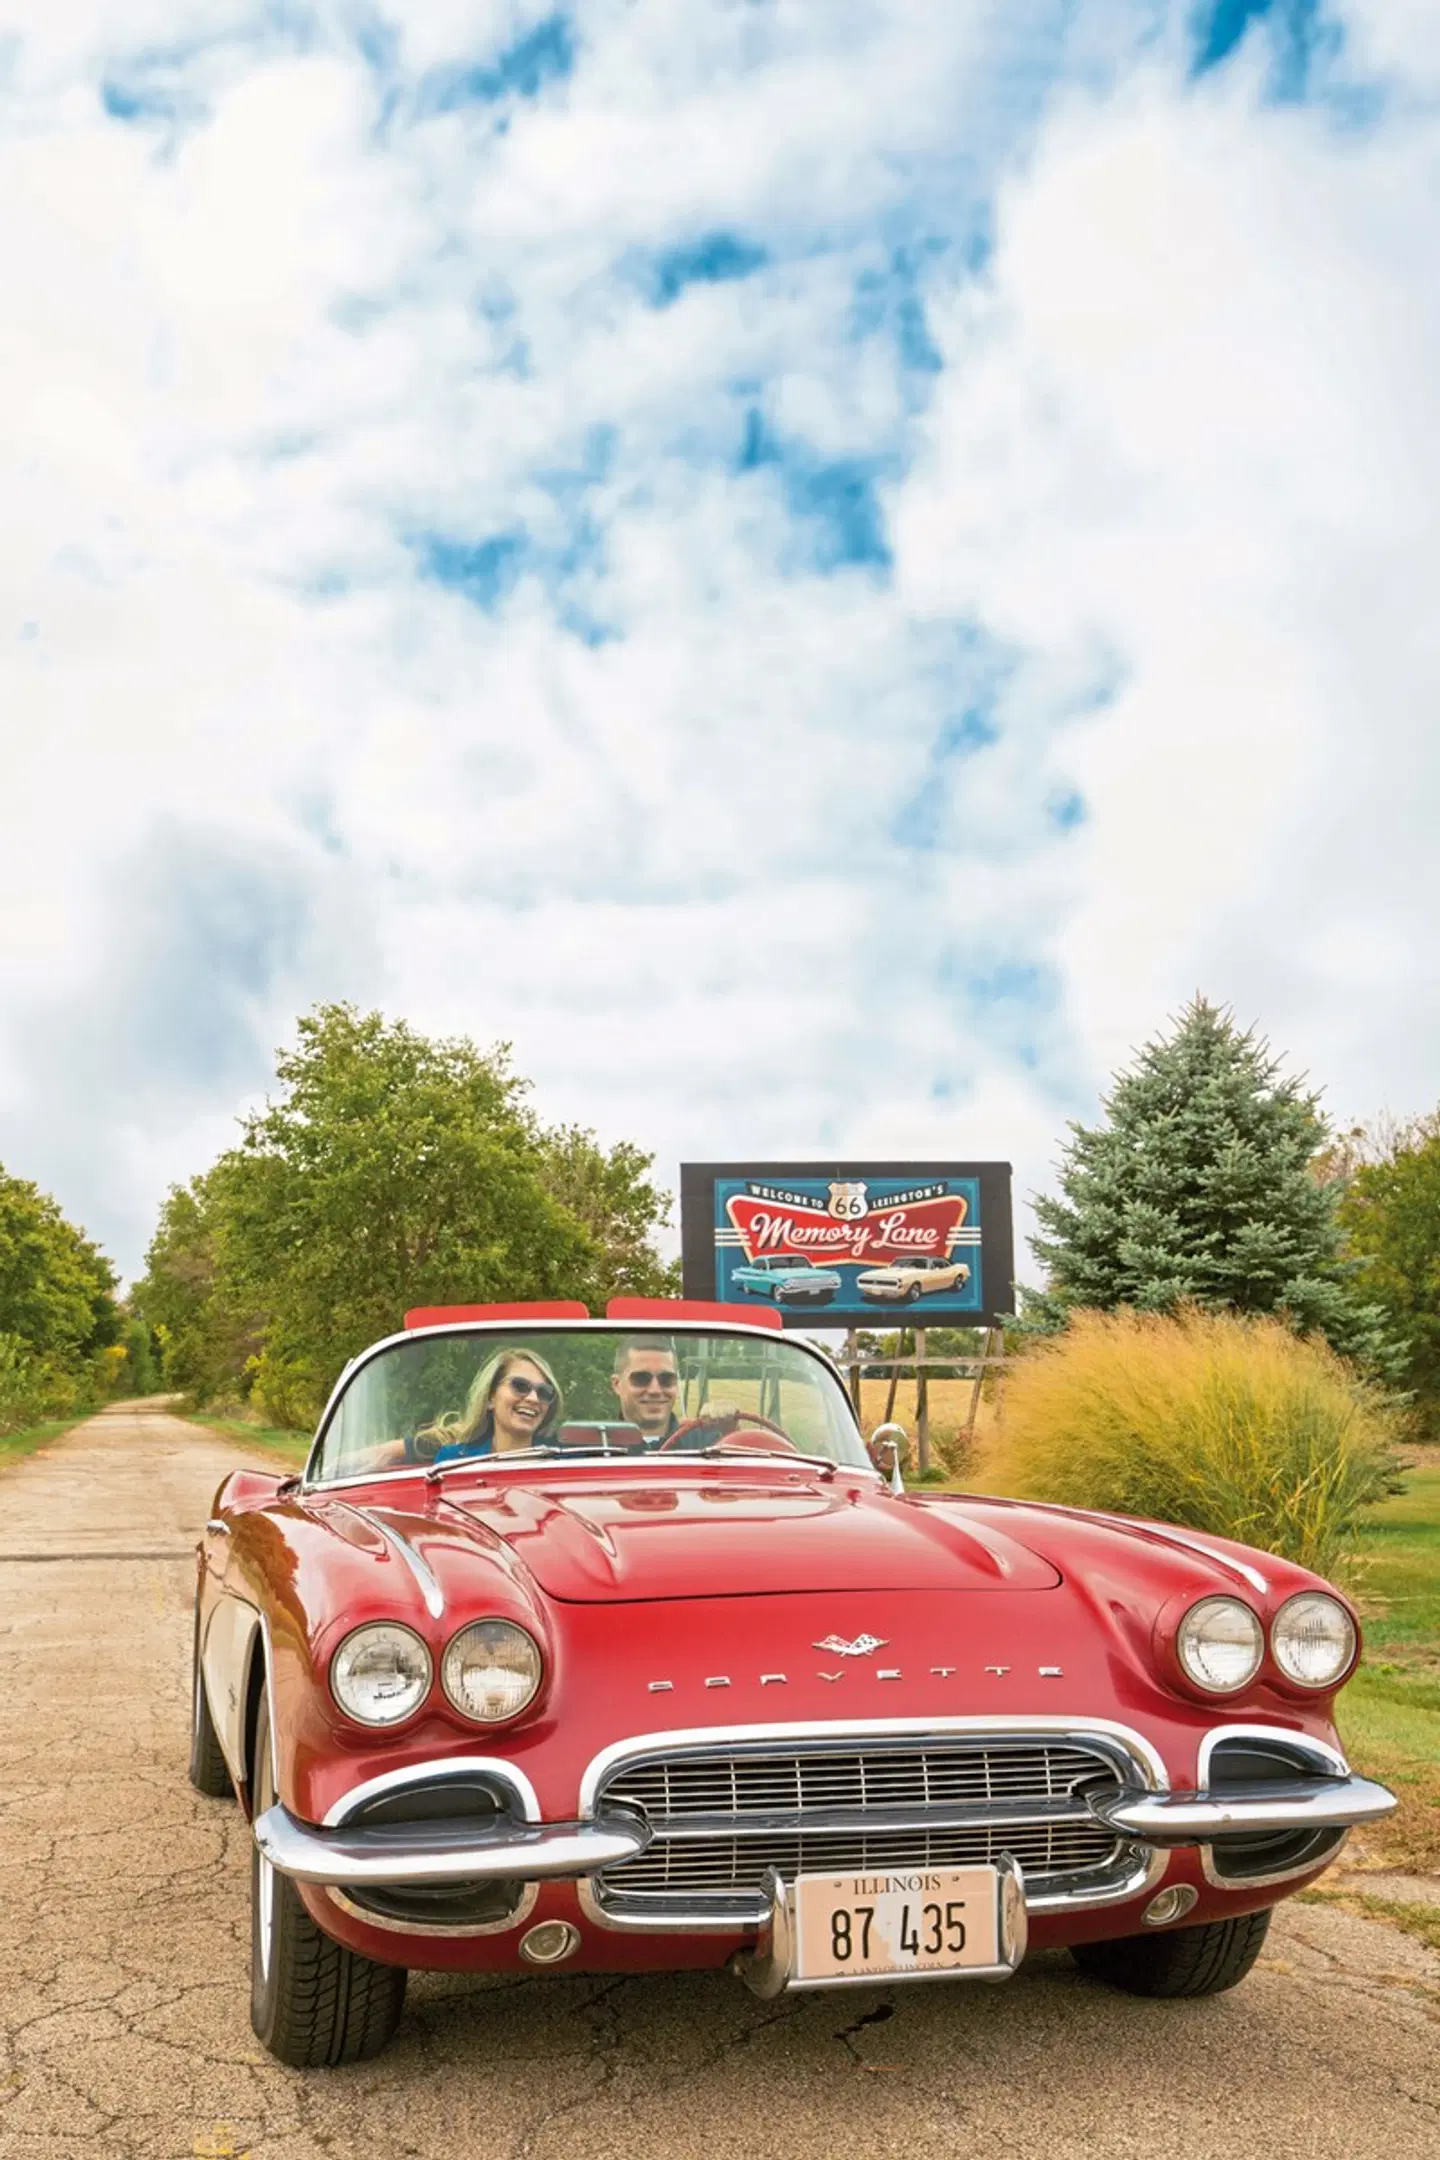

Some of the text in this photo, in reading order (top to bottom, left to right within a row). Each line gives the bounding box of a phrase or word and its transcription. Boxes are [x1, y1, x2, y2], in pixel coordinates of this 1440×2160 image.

[750, 1184, 944, 1209] WELCOME TO LEXINGTON'S
[835, 1197, 861, 1215] 66
[750, 1212, 940, 1256] Memory Lane
[648, 1665, 1065, 1692] CORVETTE
[853, 1874, 941, 1895] ILLINOIS
[831, 1901, 966, 1961] 87 435
